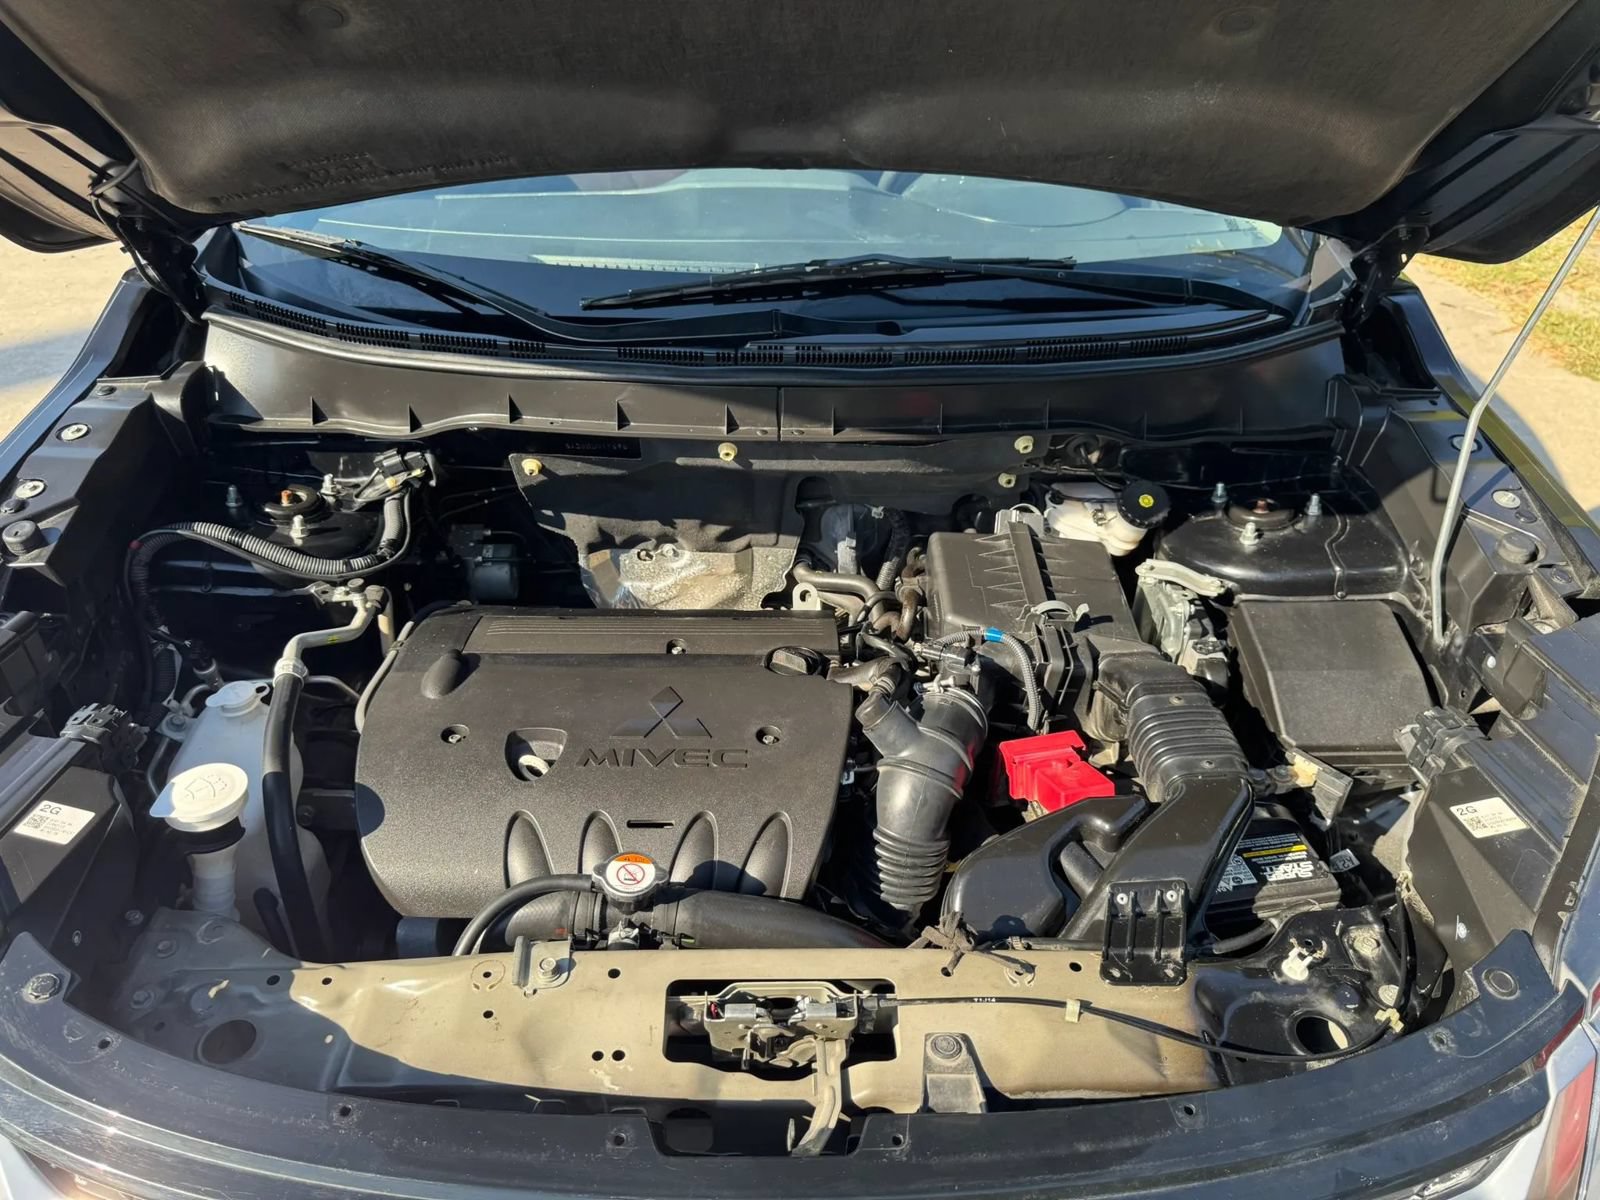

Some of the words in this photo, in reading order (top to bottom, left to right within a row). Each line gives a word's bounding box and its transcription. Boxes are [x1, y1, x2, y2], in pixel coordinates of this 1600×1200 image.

[575, 748, 749, 767] MIVEC
[40, 804, 62, 815] 2G
[1456, 805, 1477, 816] 2G
[1262, 860, 1315, 876] START
[1265, 870, 1313, 882] SUPER
